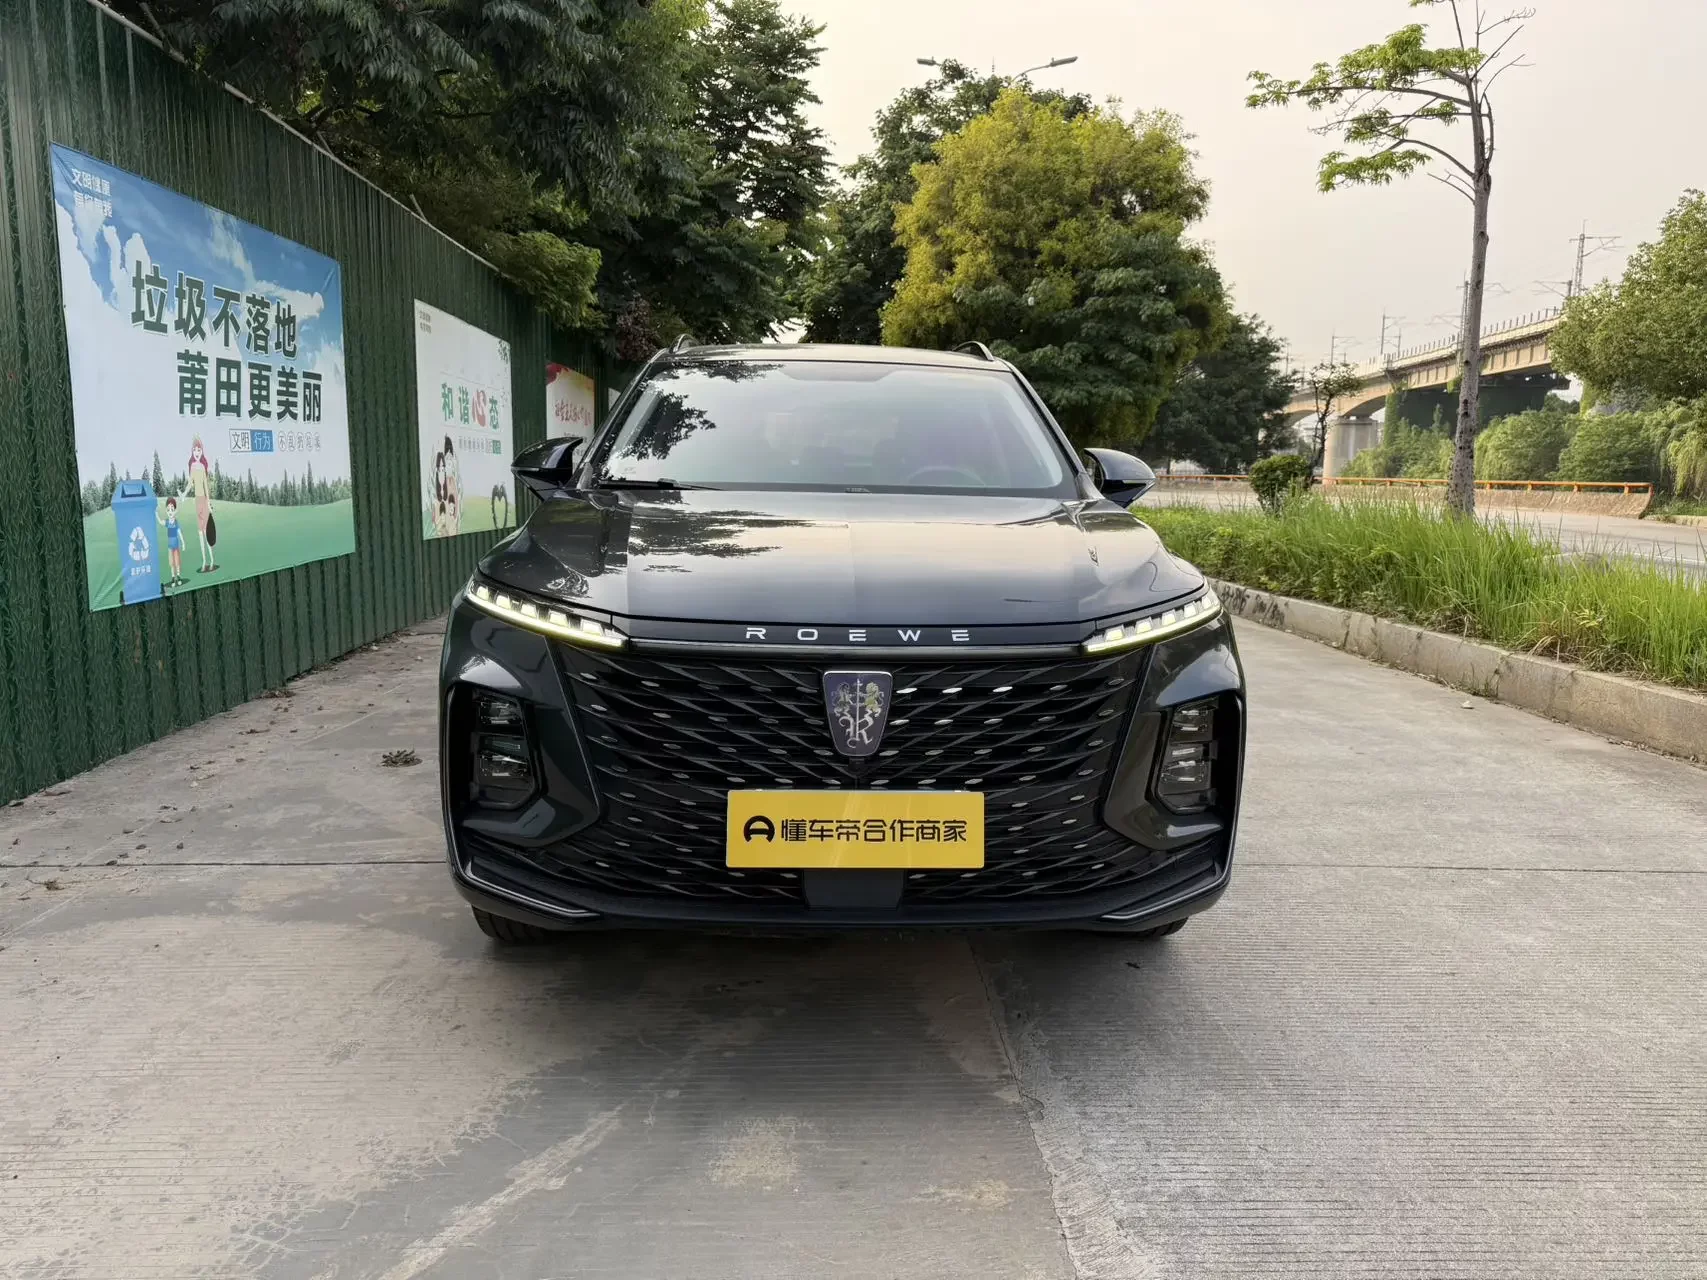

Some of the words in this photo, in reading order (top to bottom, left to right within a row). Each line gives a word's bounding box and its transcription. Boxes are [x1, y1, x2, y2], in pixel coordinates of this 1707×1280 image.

[131, 260, 298, 358] 垃圾不落地
[177, 349, 322, 423] 莆田更美丽
[441, 382, 500, 430] 和谐心态
[745, 627, 969, 641] ROEWE
[781, 818, 967, 842] 懂车帝合作商家
